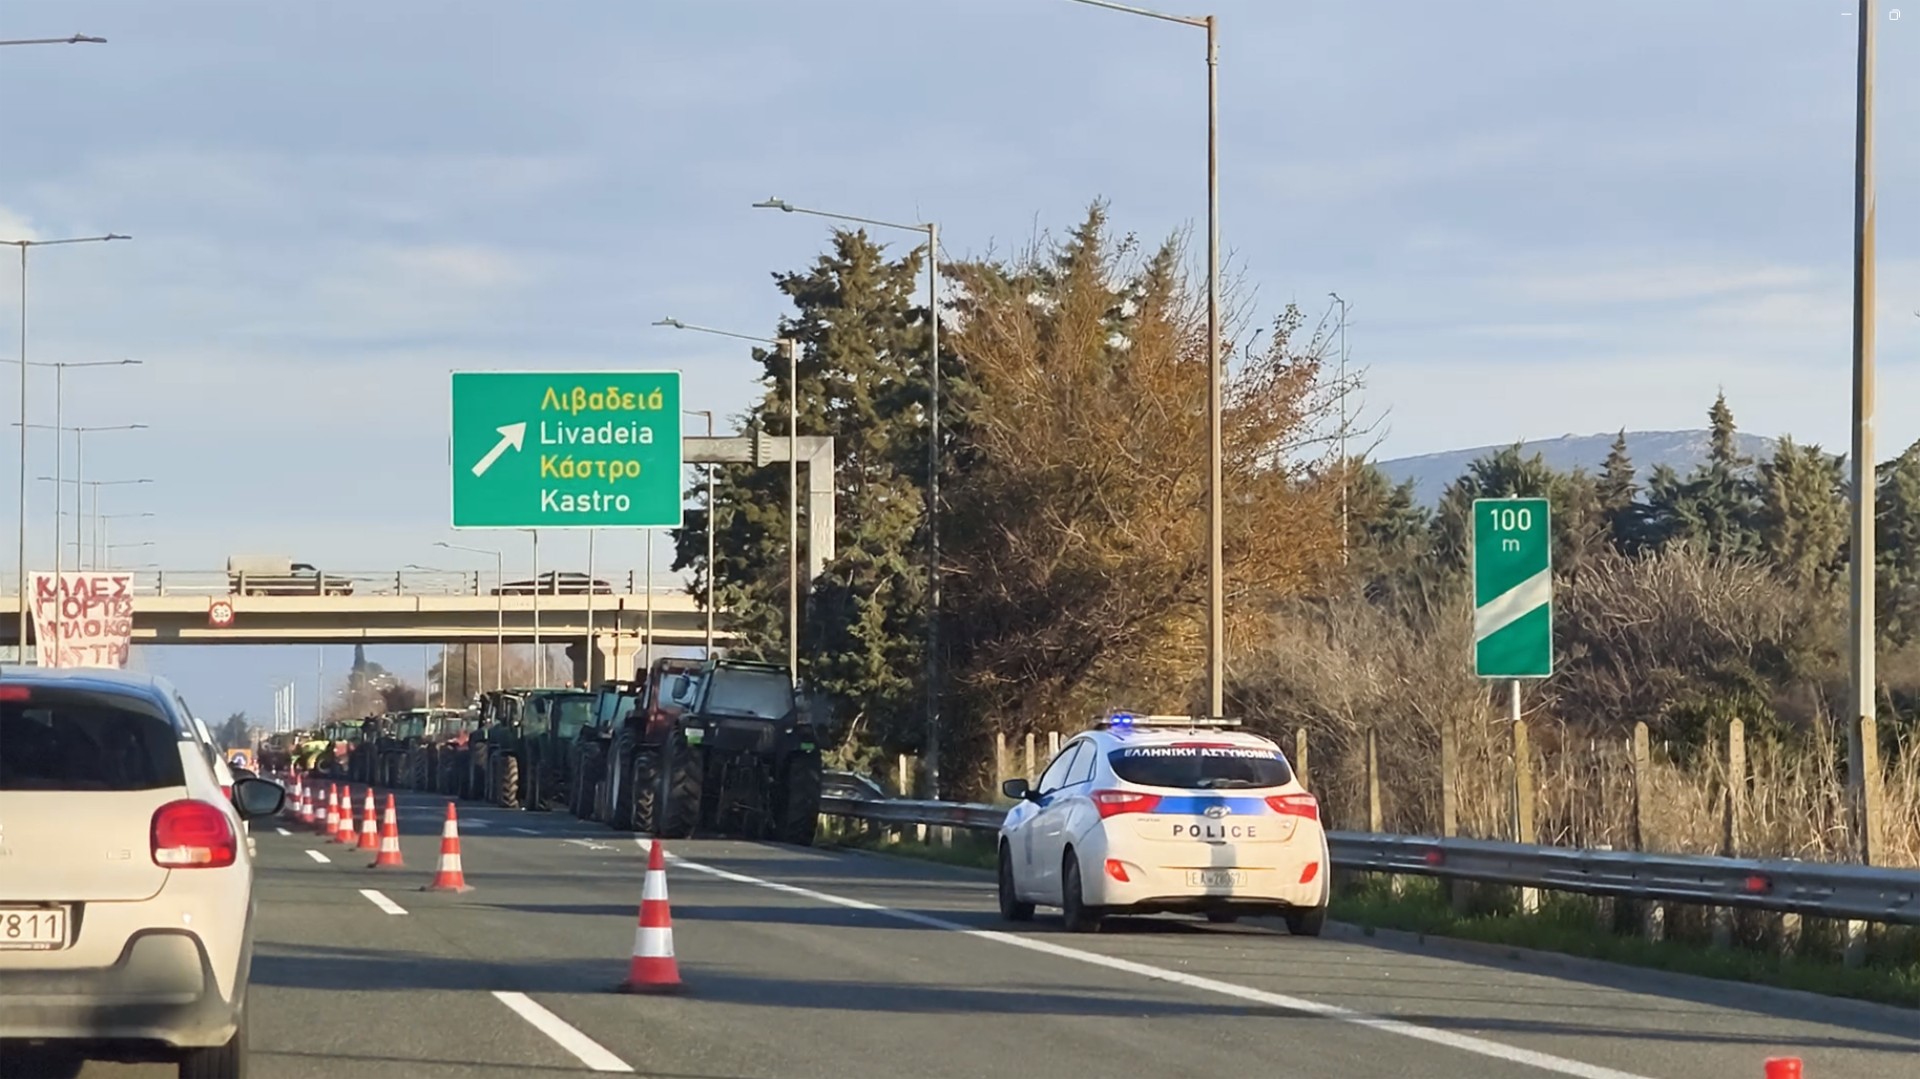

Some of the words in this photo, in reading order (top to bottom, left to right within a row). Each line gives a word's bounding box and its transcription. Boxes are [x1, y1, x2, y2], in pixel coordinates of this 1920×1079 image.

[541, 386, 664, 415] Λιβαδειά
[541, 420, 653, 444] Livadeia
[541, 454, 641, 484] Κάστρο
[541, 489, 630, 512] Kastro
[1490, 508, 1532, 531] 100
[1502, 538, 1521, 552] m
[36, 575, 130, 598] ΚΑΛΕΣ
[1124, 747, 1197, 757] ΕΛΛΗΝΙΚΗ
[1200, 747, 1278, 760] ΑΣΤΥΝΟΜΙΑ
[1172, 824, 1257, 839] POLICE
